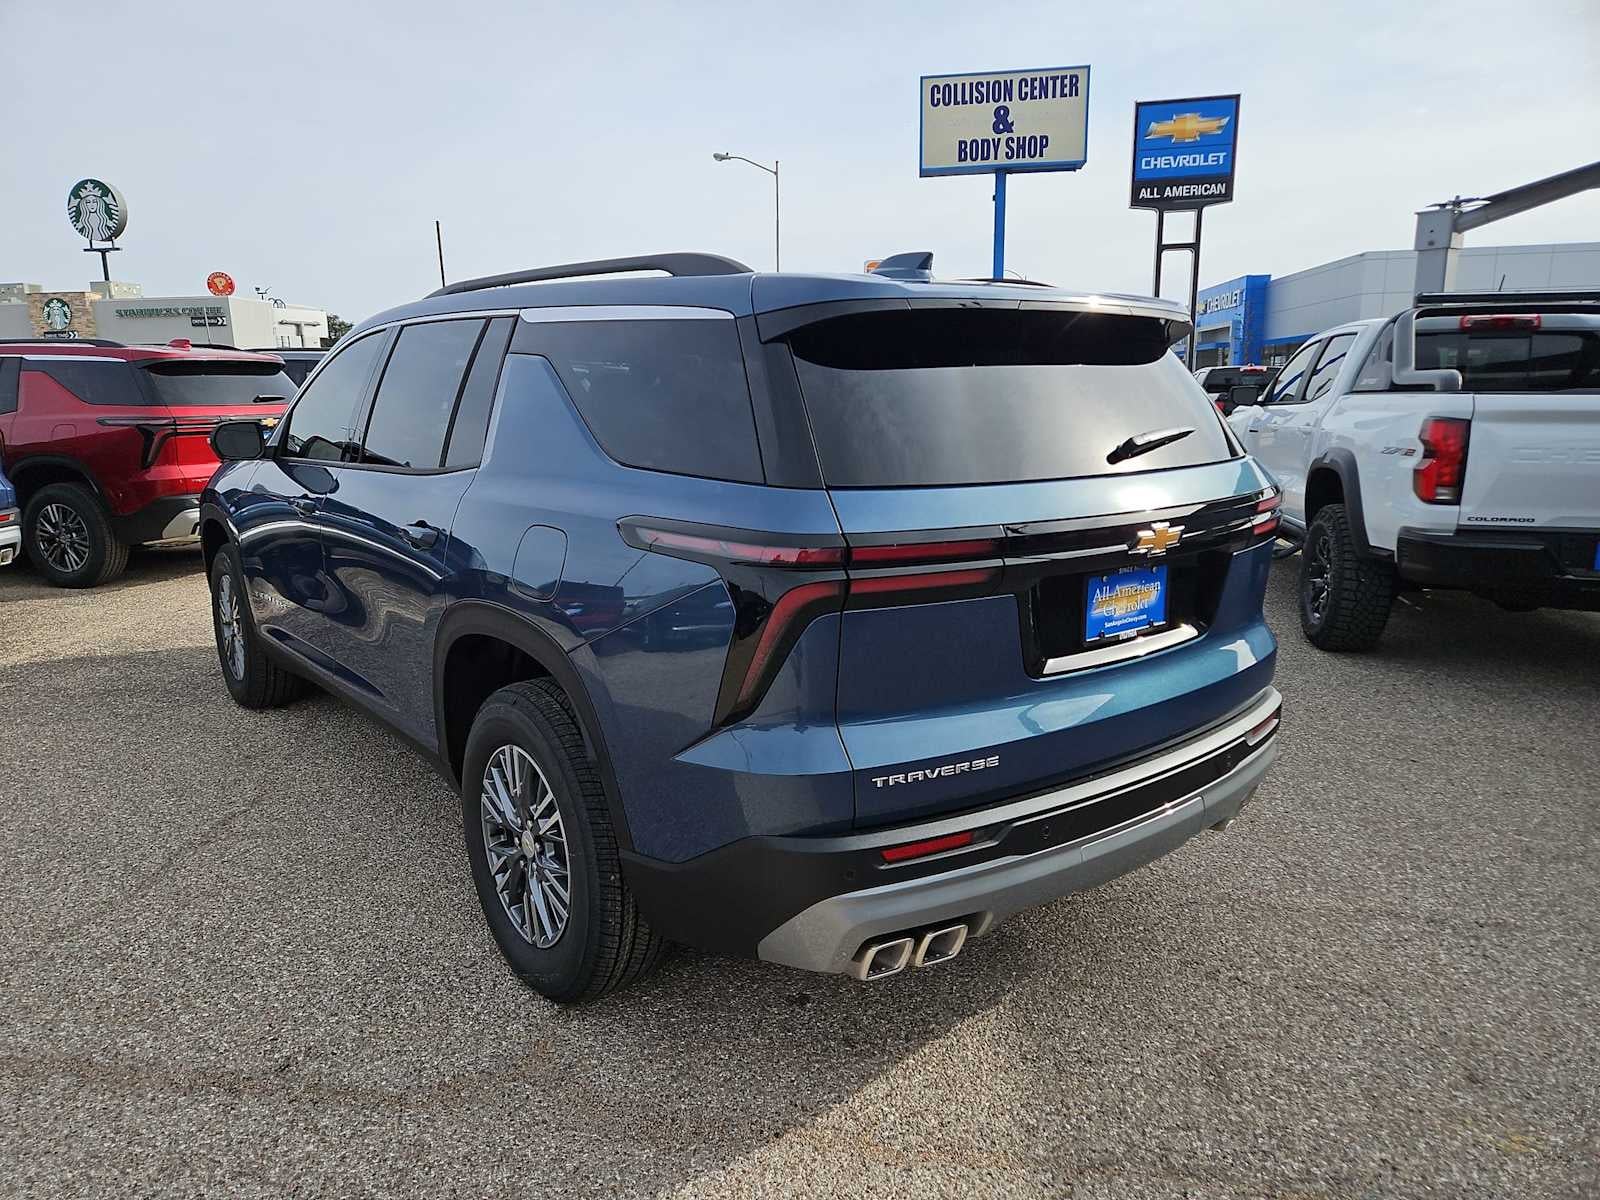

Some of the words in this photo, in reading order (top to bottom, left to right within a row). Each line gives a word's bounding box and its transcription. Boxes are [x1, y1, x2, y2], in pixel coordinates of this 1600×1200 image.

[930, 80, 1013, 107] COLLISION
[1018, 74, 1079, 101] CENTER
[992, 105, 1014, 134] &
[958, 138, 1001, 162] BODY
[1005, 135, 1049, 160] SHOP
[1141, 152, 1227, 169] CHEVROLET
[1139, 187, 1160, 199] ALL
[1163, 182, 1226, 197] AMERICAN
[1206, 288, 1246, 313] CHEVROLET
[1113, 580, 1161, 598] American
[872, 755, 1000, 788] TRAVERSE
